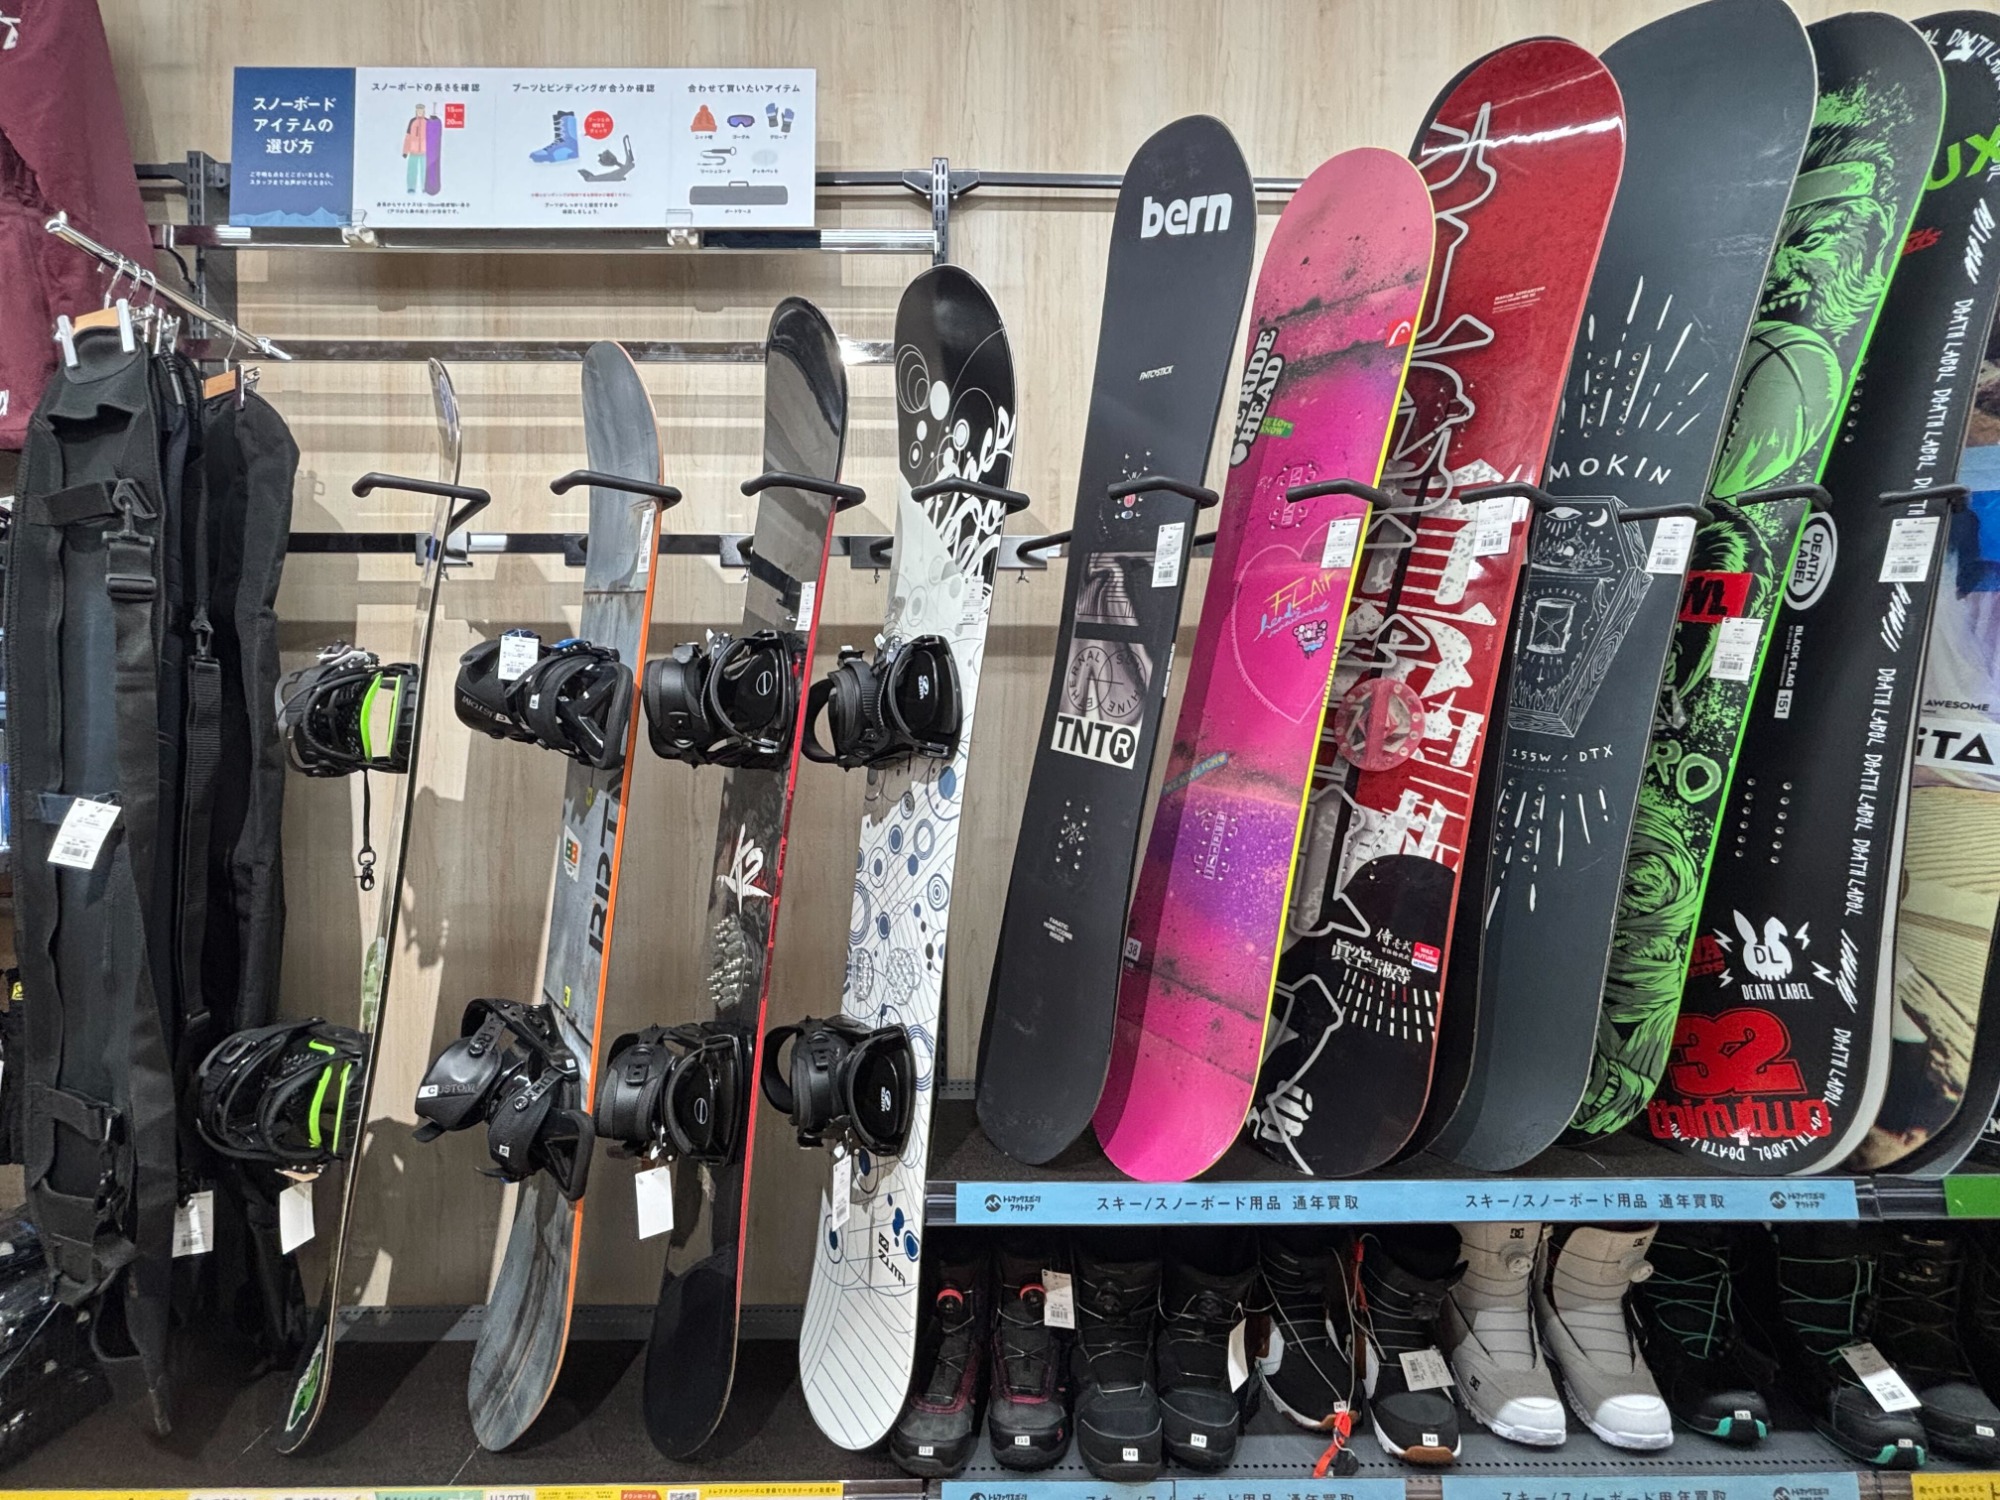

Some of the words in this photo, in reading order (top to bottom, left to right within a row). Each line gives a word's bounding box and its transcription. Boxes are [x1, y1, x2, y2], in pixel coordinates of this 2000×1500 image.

[372, 82, 480, 92] スノーボードの長さを確認
[512, 83, 655, 93] ブーツとビンディングが合うか確認
[688, 83, 800, 93] 合わせて買いたいアイテム
[252, 97, 336, 111] スノーボード
[254, 118, 334, 133] アイテムの
[266, 139, 314, 154] 選び方
[1141, 193, 1232, 239] bern
[1805, 532, 1825, 586] DEATH
[1777, 693, 1790, 714] 151
[1924, 700, 1990, 712] AWESOME
[1511, 748, 1551, 763] 155W
[1579, 744, 1614, 763] DTX
[1127, 942, 1138, 955] 38
[1741, 984, 1775, 1000] DEATH
[1778, 983, 1814, 1000] LABEL
[1097, 1195, 1281, 1211] スキー/スノーボード用品
[1292, 1194, 1359, 1210] 通年買取
[1466, 1193, 1648, 1209] スキー/スノーボード用品
[1659, 1193, 1725, 1209] 通年買取
